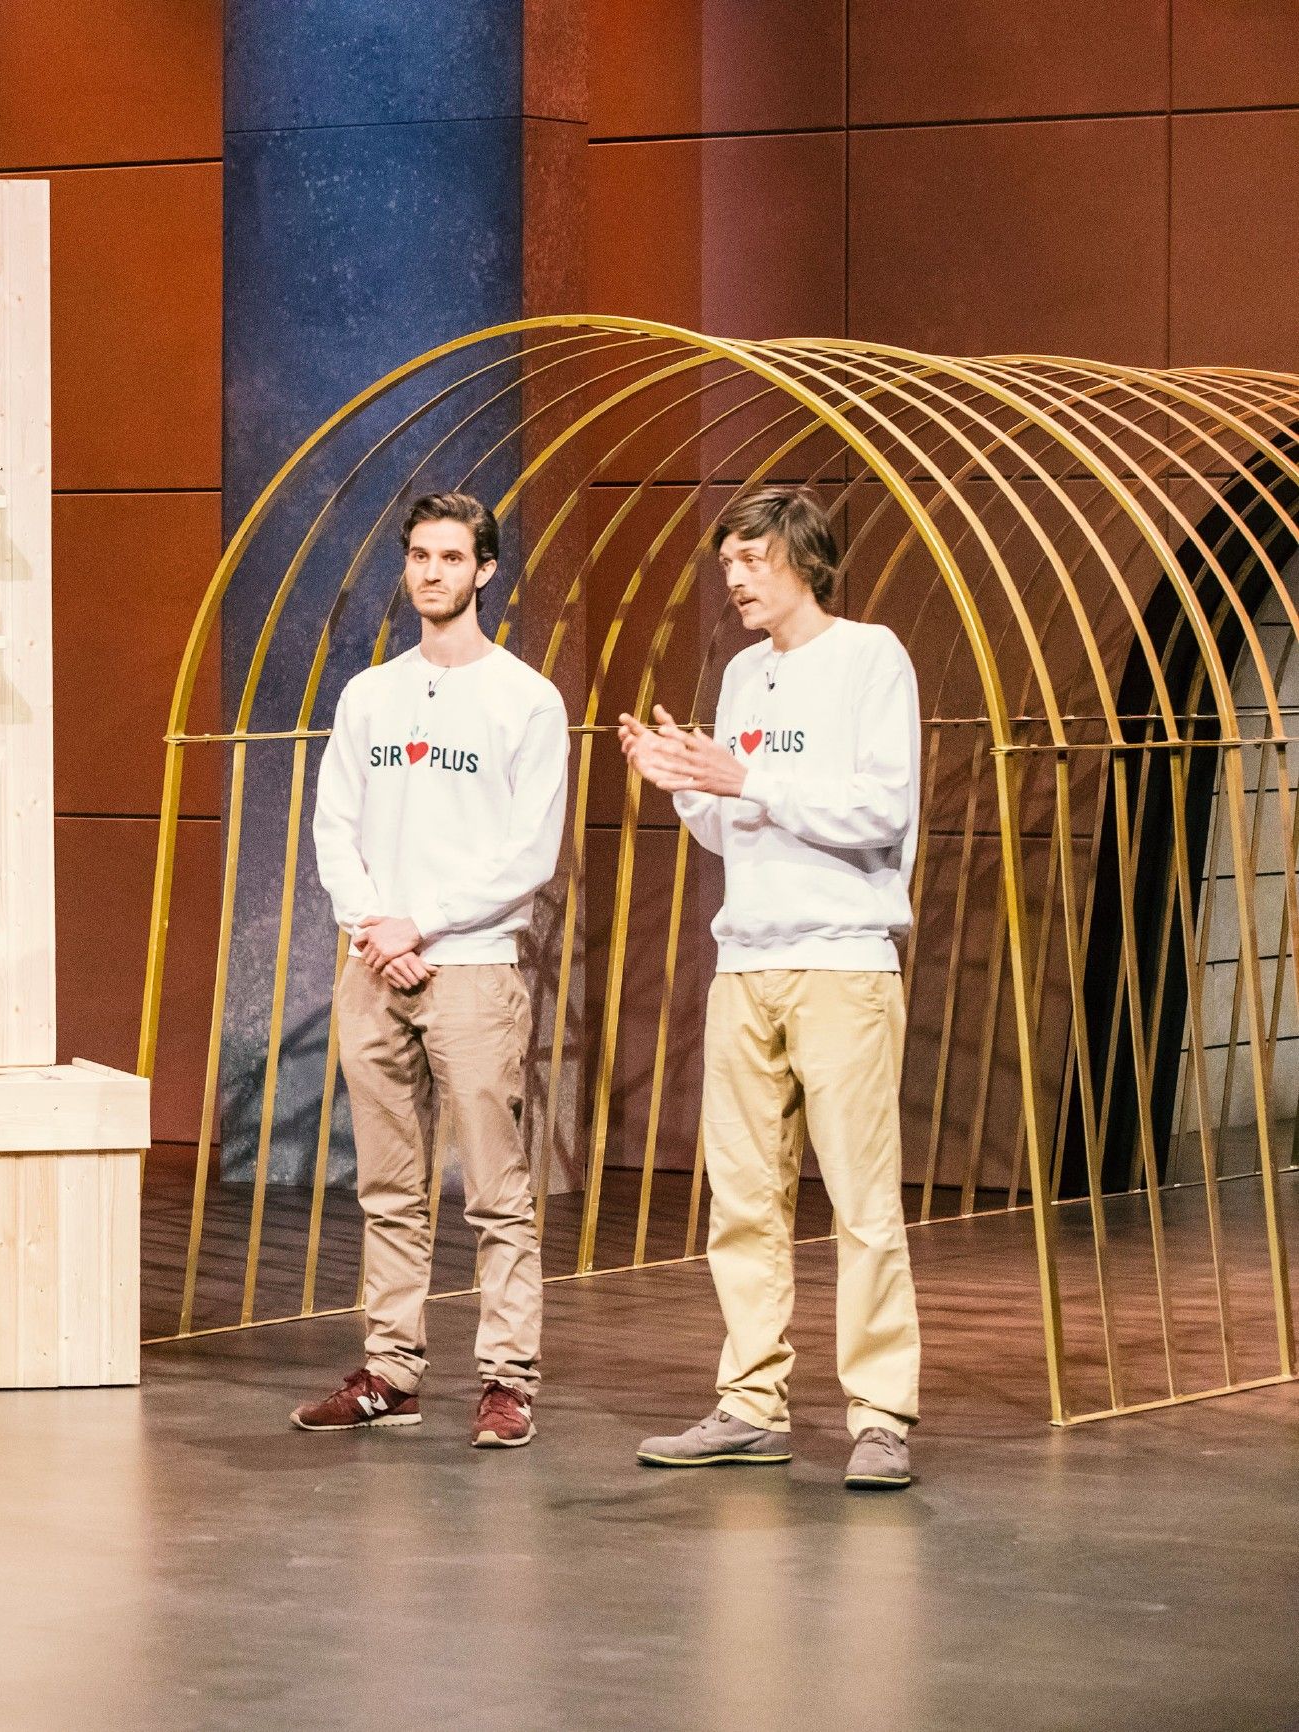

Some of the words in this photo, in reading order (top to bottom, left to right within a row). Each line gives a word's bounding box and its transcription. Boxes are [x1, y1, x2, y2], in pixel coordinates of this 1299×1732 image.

[764, 730, 804, 753] PLUS
[370, 745, 403, 767] SIR
[429, 746, 479, 773] PLUS
